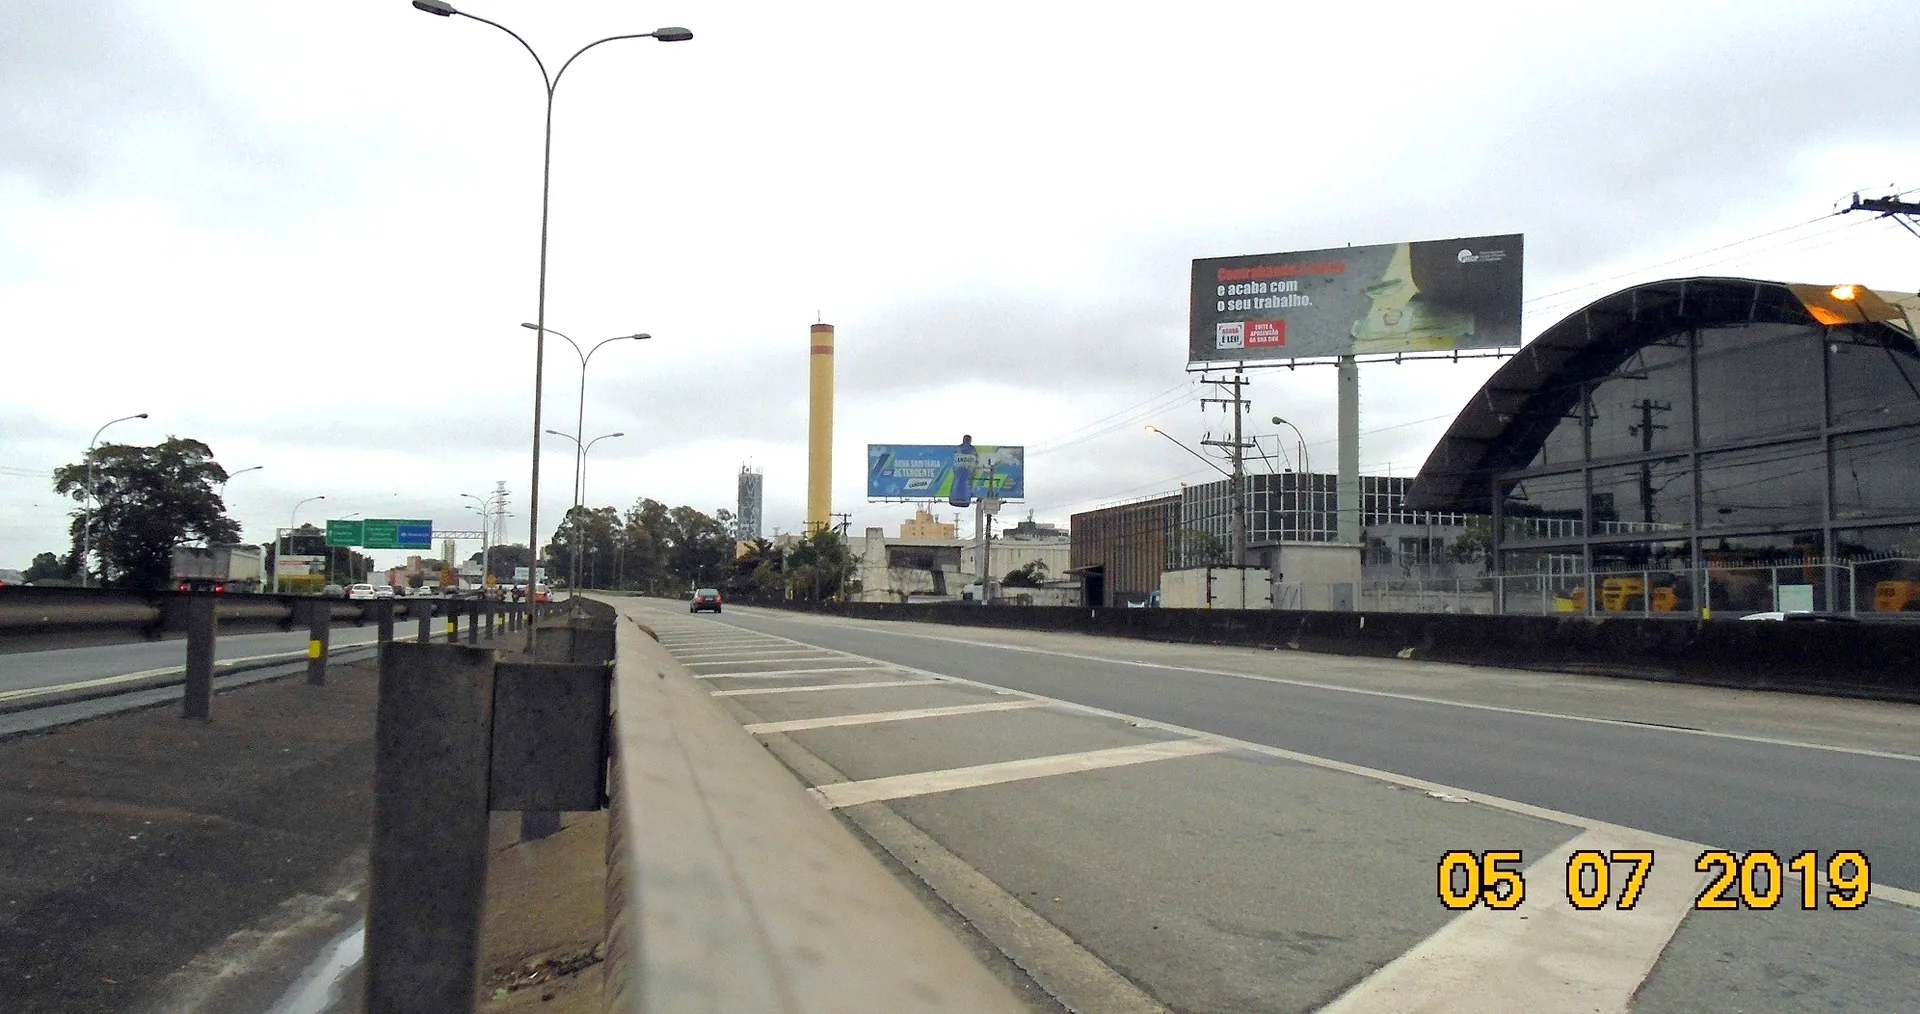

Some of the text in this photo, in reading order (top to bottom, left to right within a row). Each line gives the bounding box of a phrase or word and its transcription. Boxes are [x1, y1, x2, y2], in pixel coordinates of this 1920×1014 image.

[1217, 280, 1298, 297] e acaba com
[1217, 294, 1313, 312] o seu trabalho.
